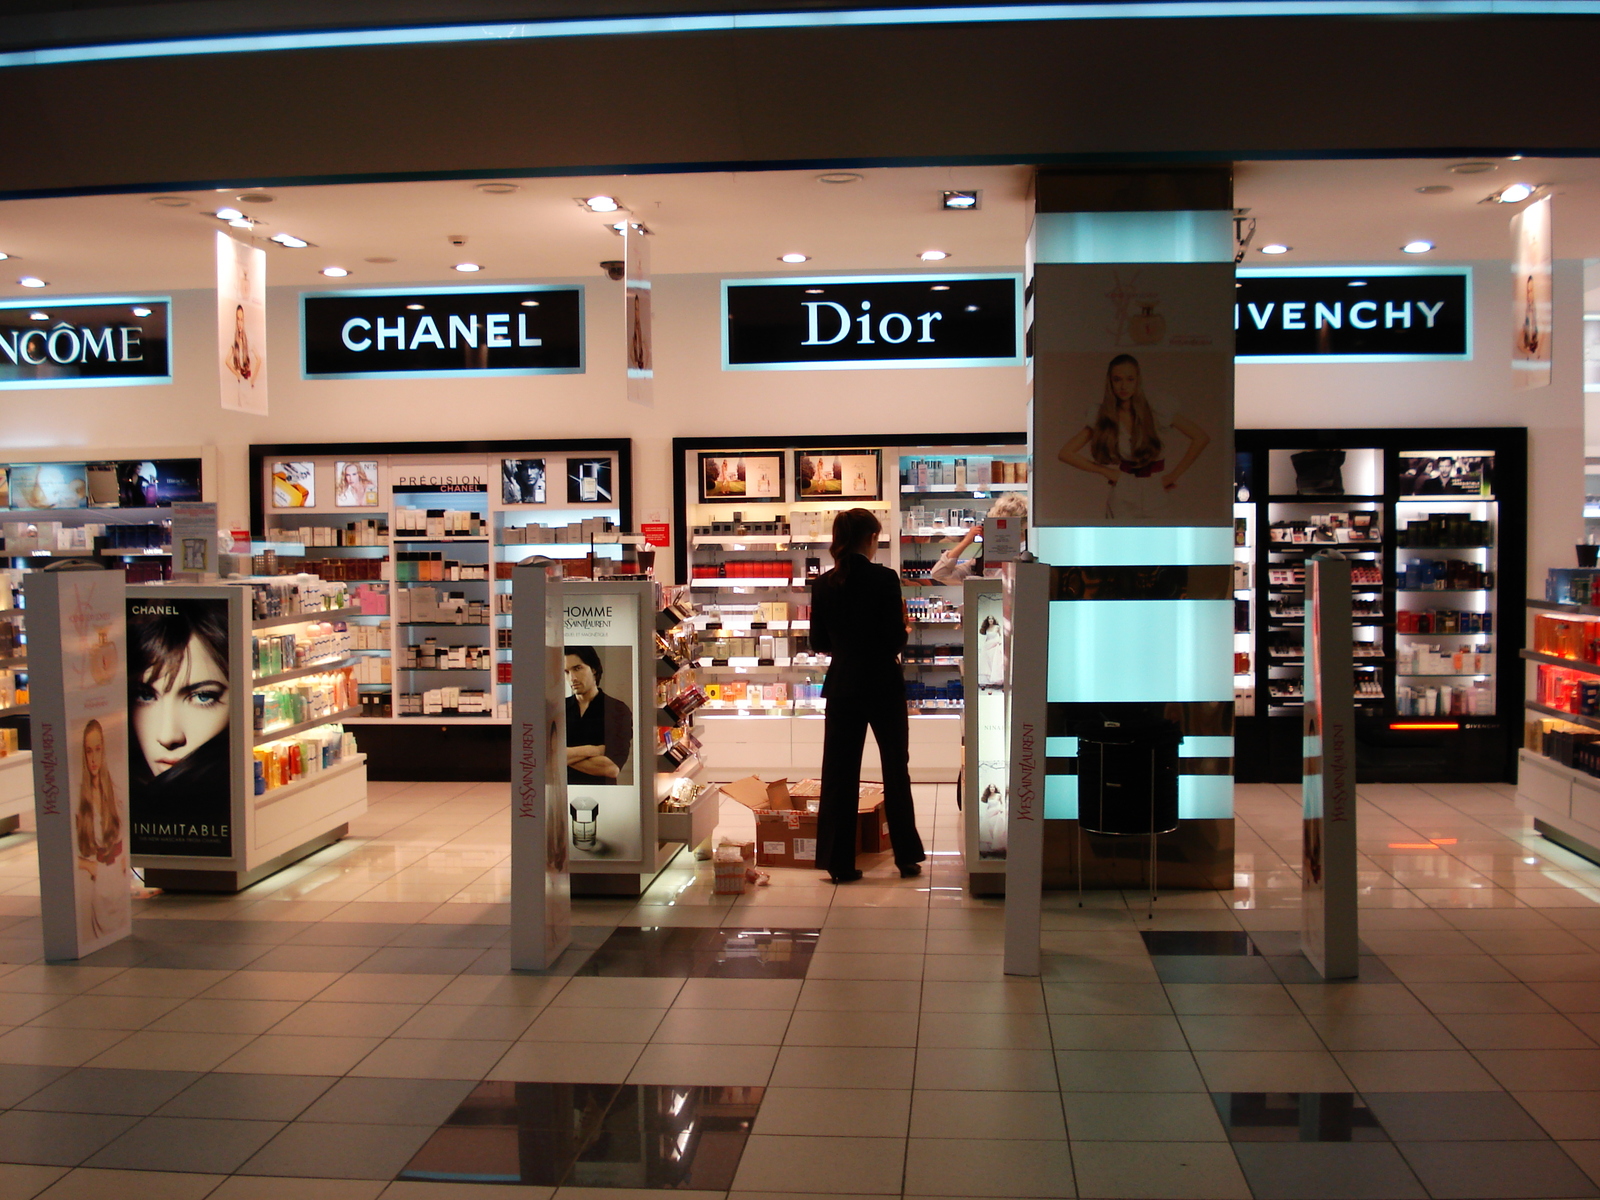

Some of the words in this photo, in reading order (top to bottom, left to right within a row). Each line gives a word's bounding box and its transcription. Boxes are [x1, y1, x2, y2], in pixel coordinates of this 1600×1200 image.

[801, 300, 943, 346] Dior
[341, 313, 543, 352] CHANEL
[399, 475, 481, 486] PRÉCISION
[440, 484, 481, 492] CHANEL
[131, 605, 180, 615] CHANEL
[134, 823, 229, 837] INIMITABLE
